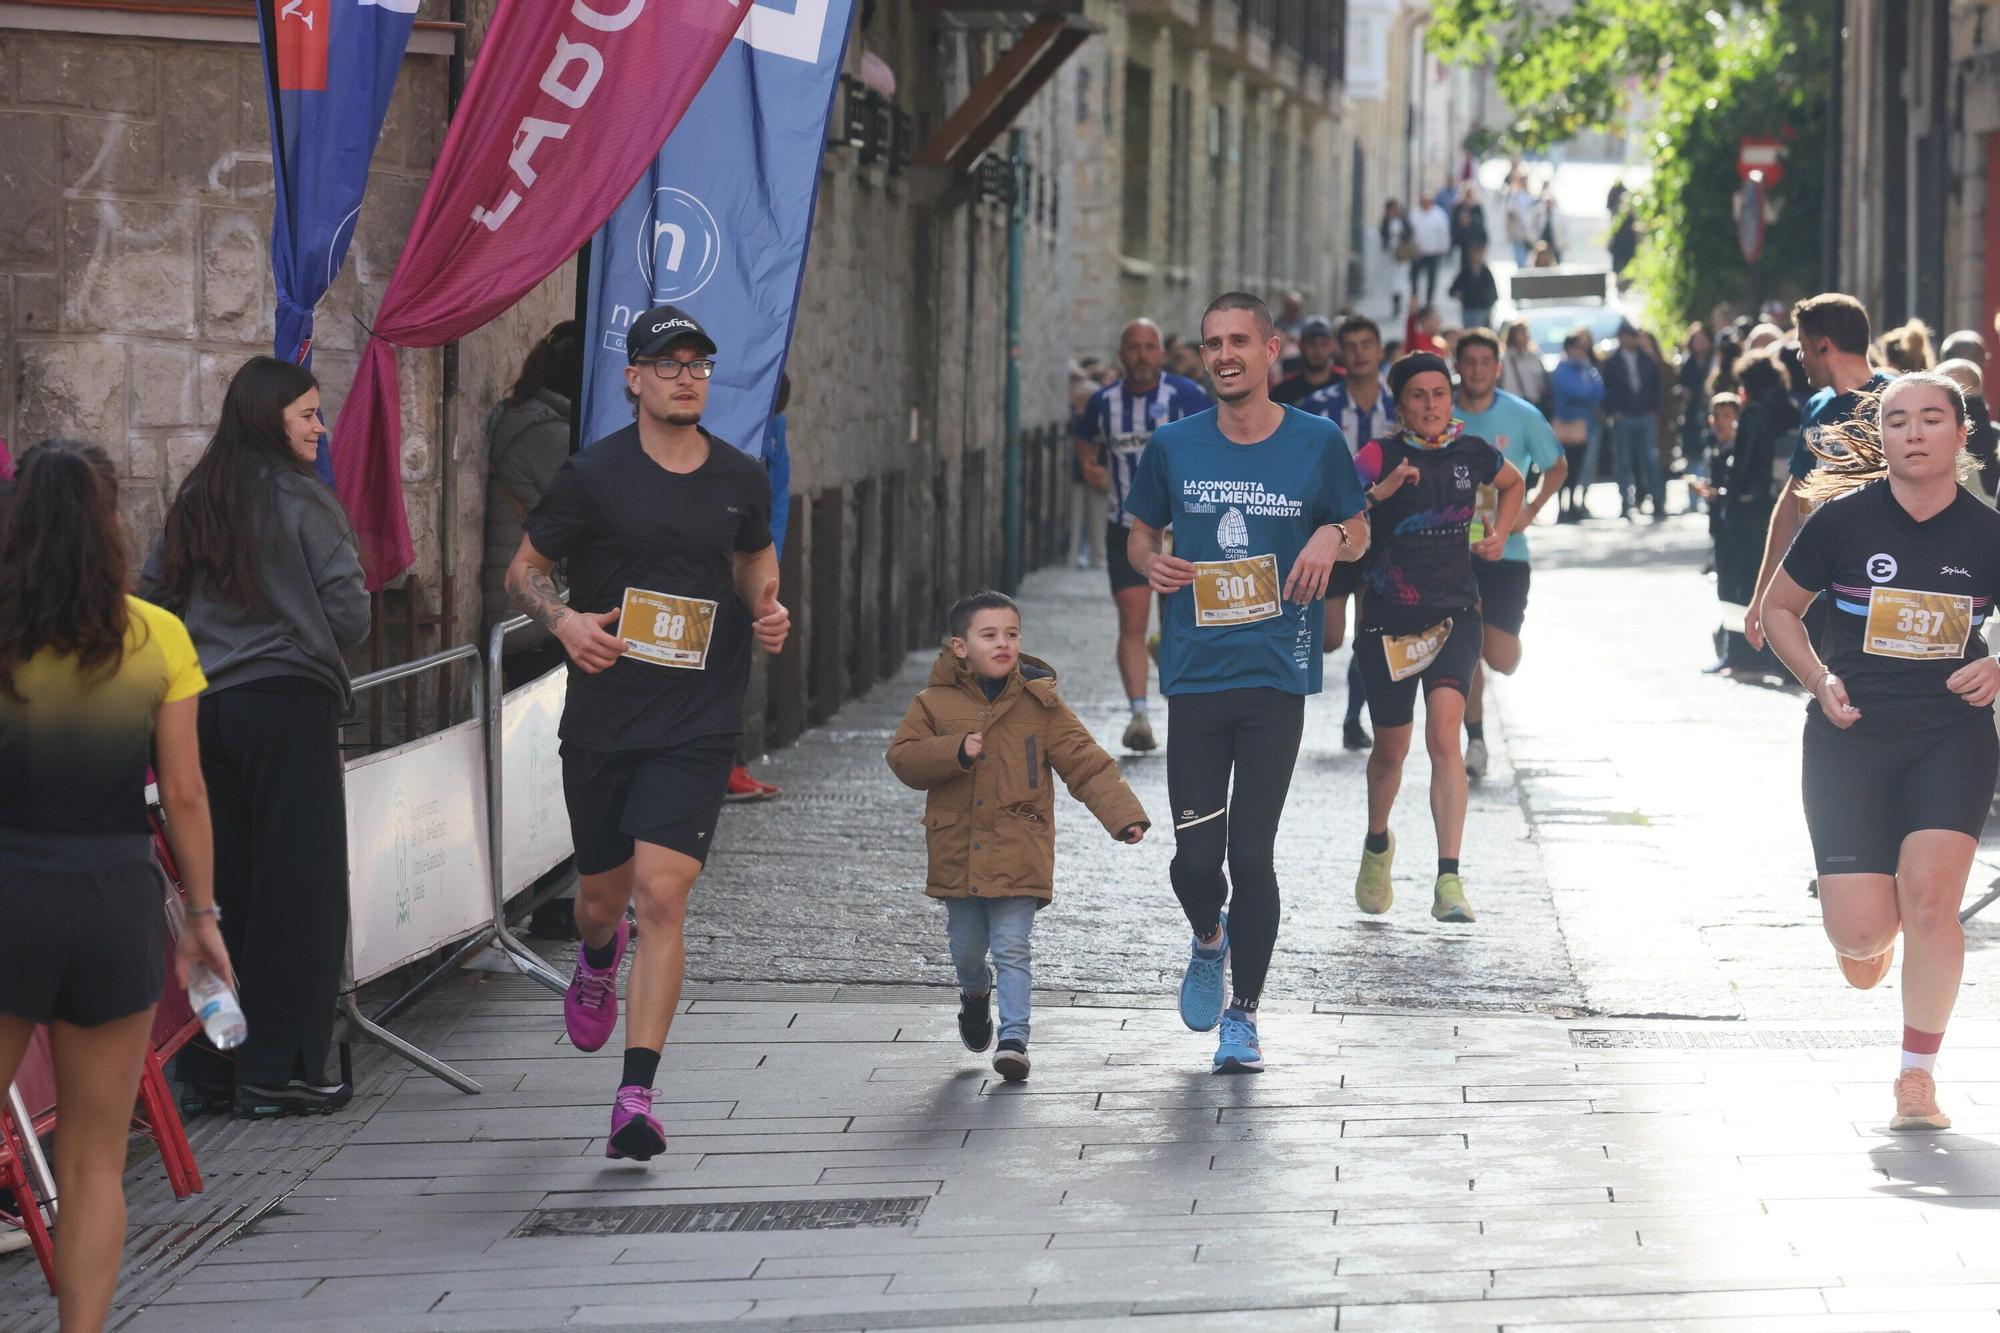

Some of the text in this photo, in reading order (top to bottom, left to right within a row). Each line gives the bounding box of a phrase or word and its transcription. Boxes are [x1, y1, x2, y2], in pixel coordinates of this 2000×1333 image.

[1183, 480, 1265, 492] LA CONQUISTA
[1199, 490, 1288, 507] ALMENDRA
[1246, 505, 1301, 517] KONKISTA
[1260, 560, 1272, 569] 10K
[1215, 574, 1256, 601] 301
[1953, 602, 1966, 610] 10K
[653, 612, 686, 641] 88
[1896, 608, 1945, 637] 337
